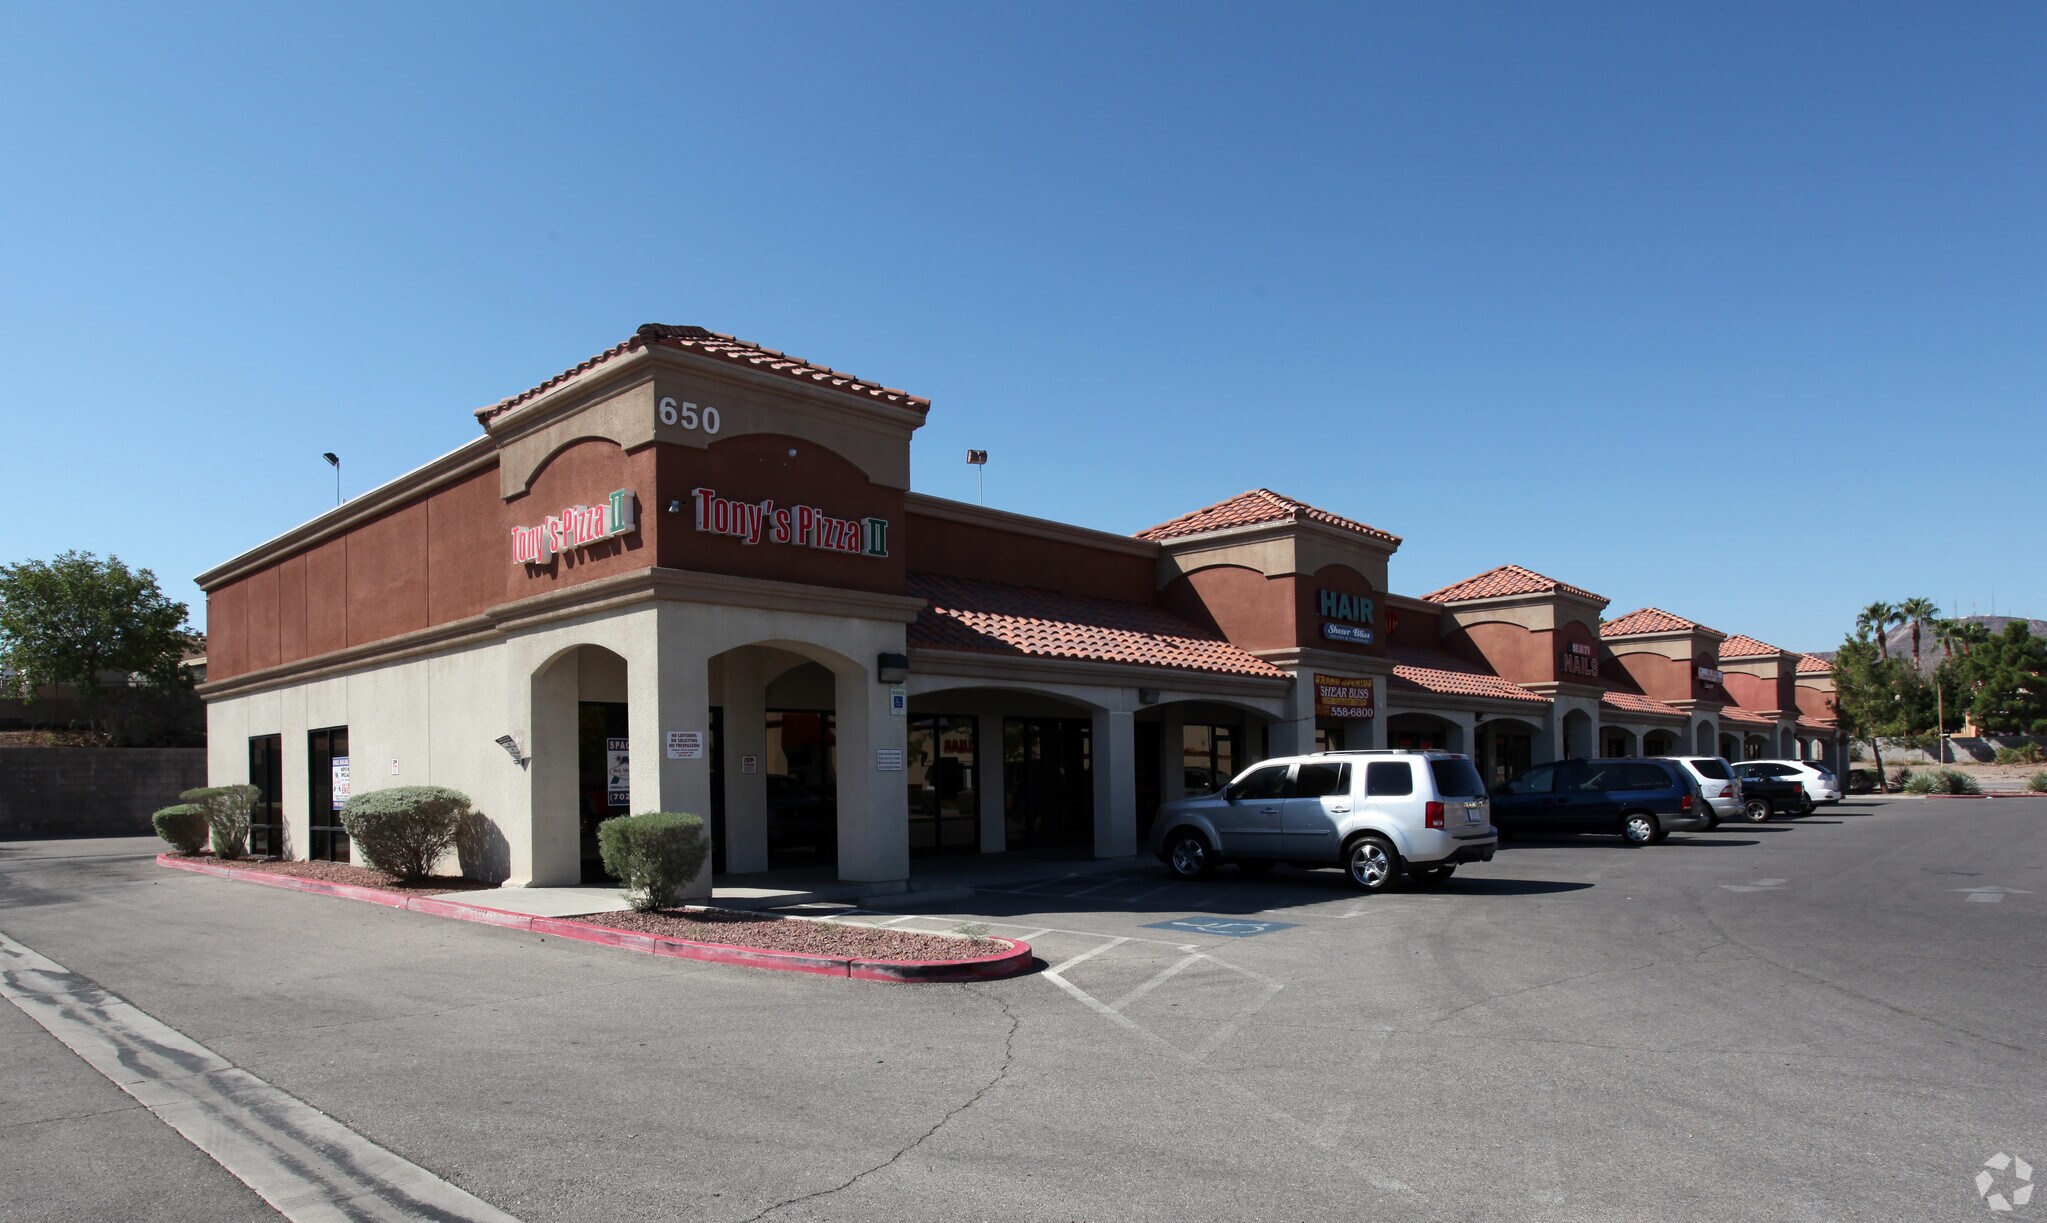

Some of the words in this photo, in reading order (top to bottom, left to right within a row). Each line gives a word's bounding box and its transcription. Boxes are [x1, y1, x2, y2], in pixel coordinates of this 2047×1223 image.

[658, 396, 721, 435] 650
[511, 514, 559, 565] Tony's
[562, 503, 605, 550] Pizza
[697, 488, 791, 545] Tony's
[797, 504, 862, 554] Pizza
[1320, 589, 1374, 624] HAIR
[1327, 624, 1351, 636] Shear
[1352, 628, 1371, 639] Bliss
[1563, 653, 1599, 677] NAILS
[1320, 685, 1347, 698] SHEAR
[1348, 687, 1369, 699] BLISS
[1330, 706, 1374, 718] 558-6800
